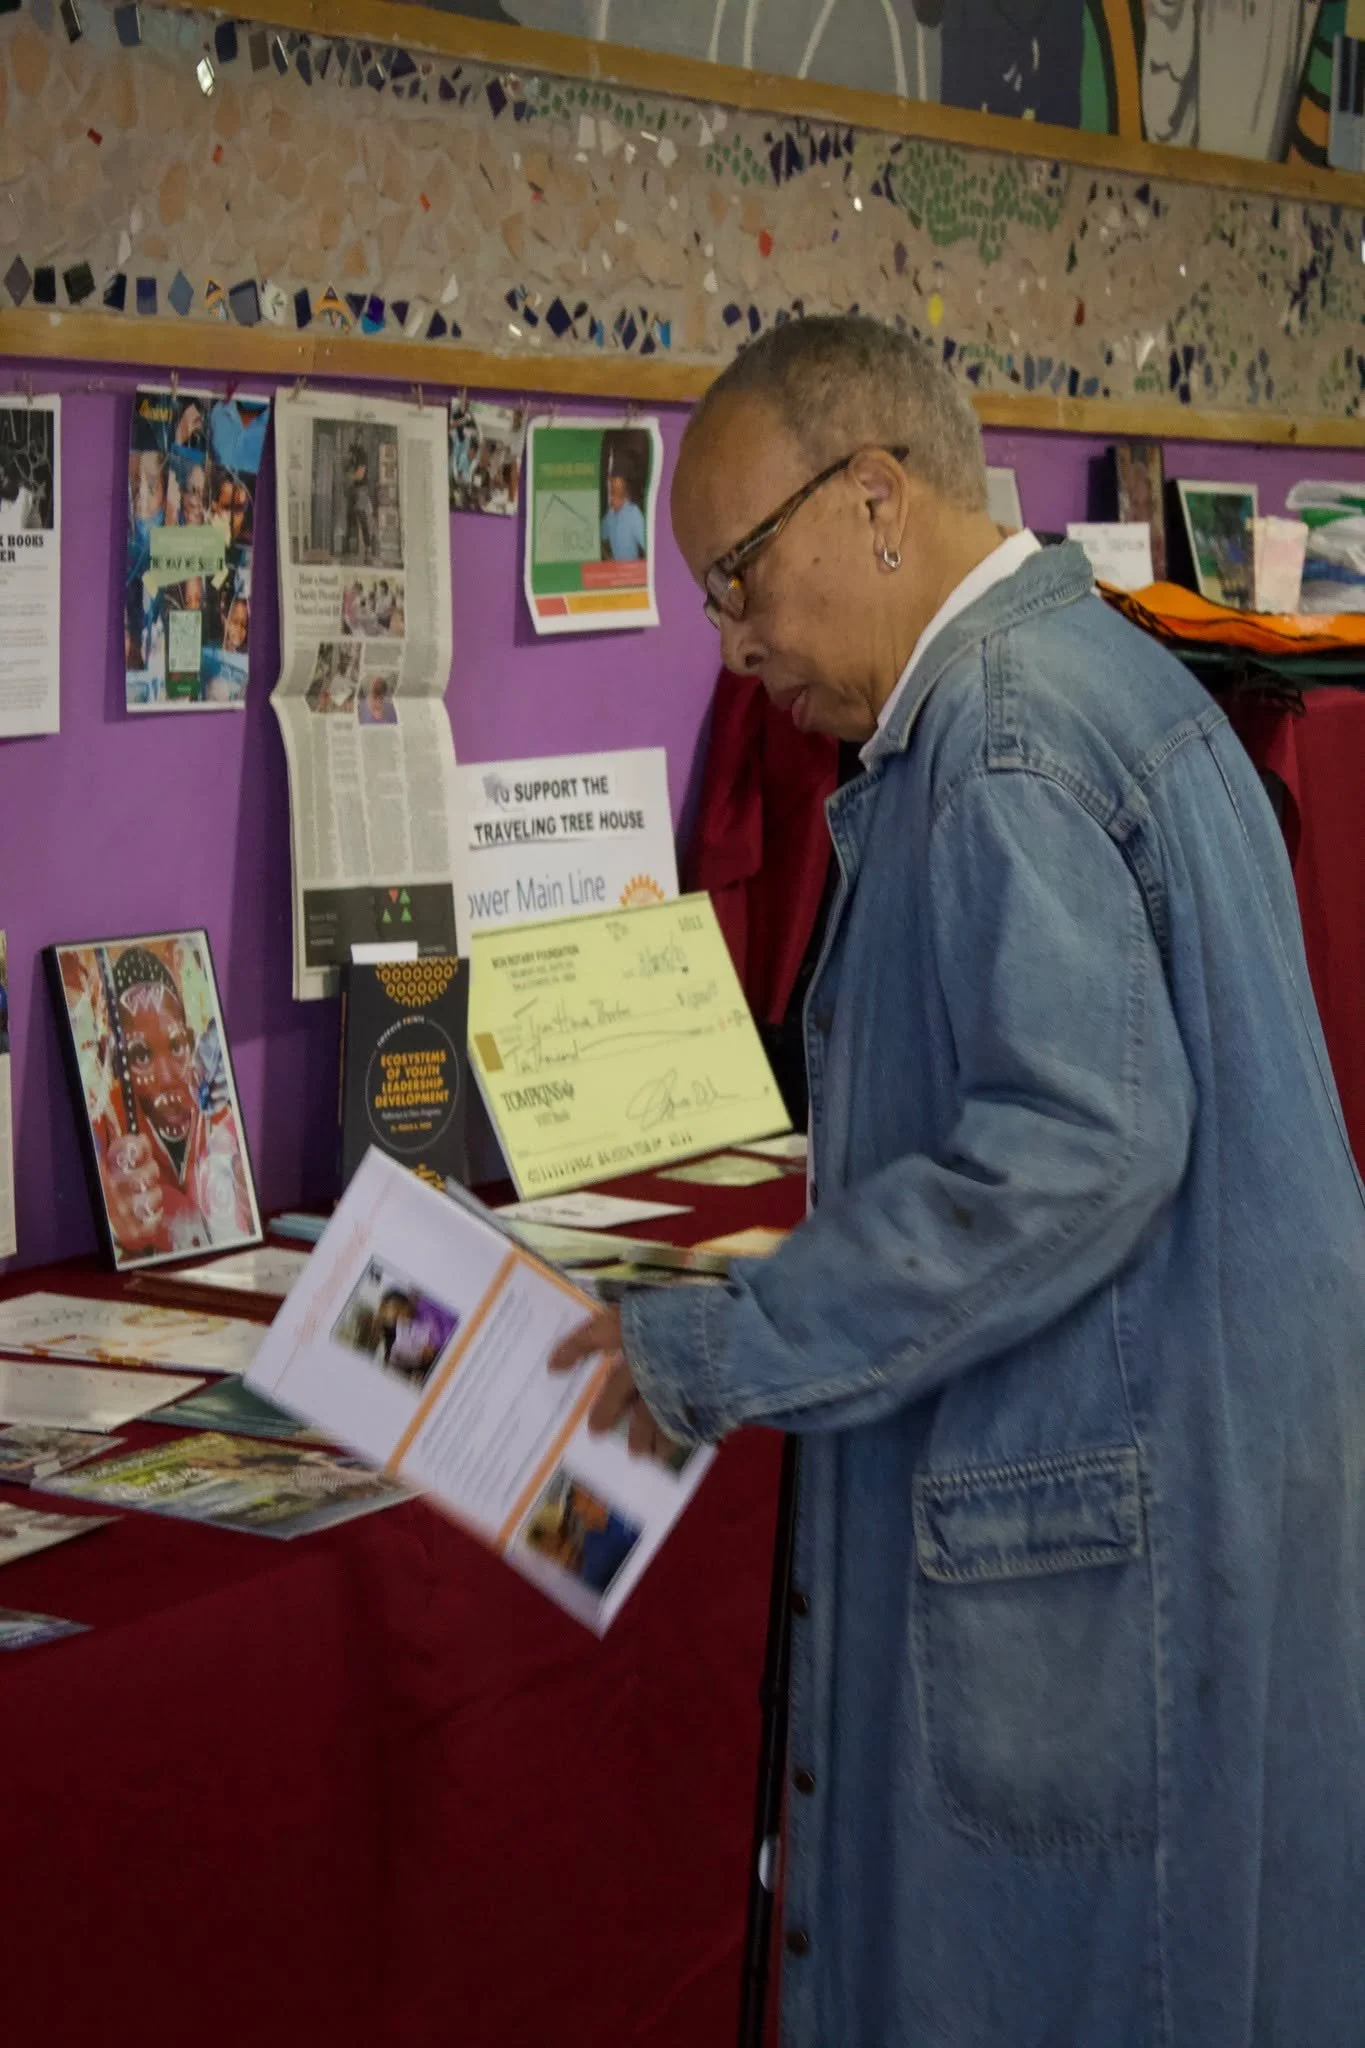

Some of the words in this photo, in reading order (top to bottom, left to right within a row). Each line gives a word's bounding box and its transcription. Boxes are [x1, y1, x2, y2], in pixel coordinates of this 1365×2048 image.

[7, 533, 44, 548] BOOKS
[514, 778, 578, 803] SUPPORT
[582, 775, 609, 796] THE
[474, 815, 557, 845] TRAVELING
[560, 811, 595, 834] TREE
[599, 810, 646, 830] HOUSE
[515, 874, 565, 913] Main
[568, 868, 607, 905] Line
[380, 1050, 447, 1068] ECOSYSTEMS
[386, 1067, 400, 1081] OF
[405, 1064, 440, 1079] YOUTH
[382, 1076, 444, 1095] LEADERSHIP
[374, 1089, 450, 1109] DEVELOPMENT
